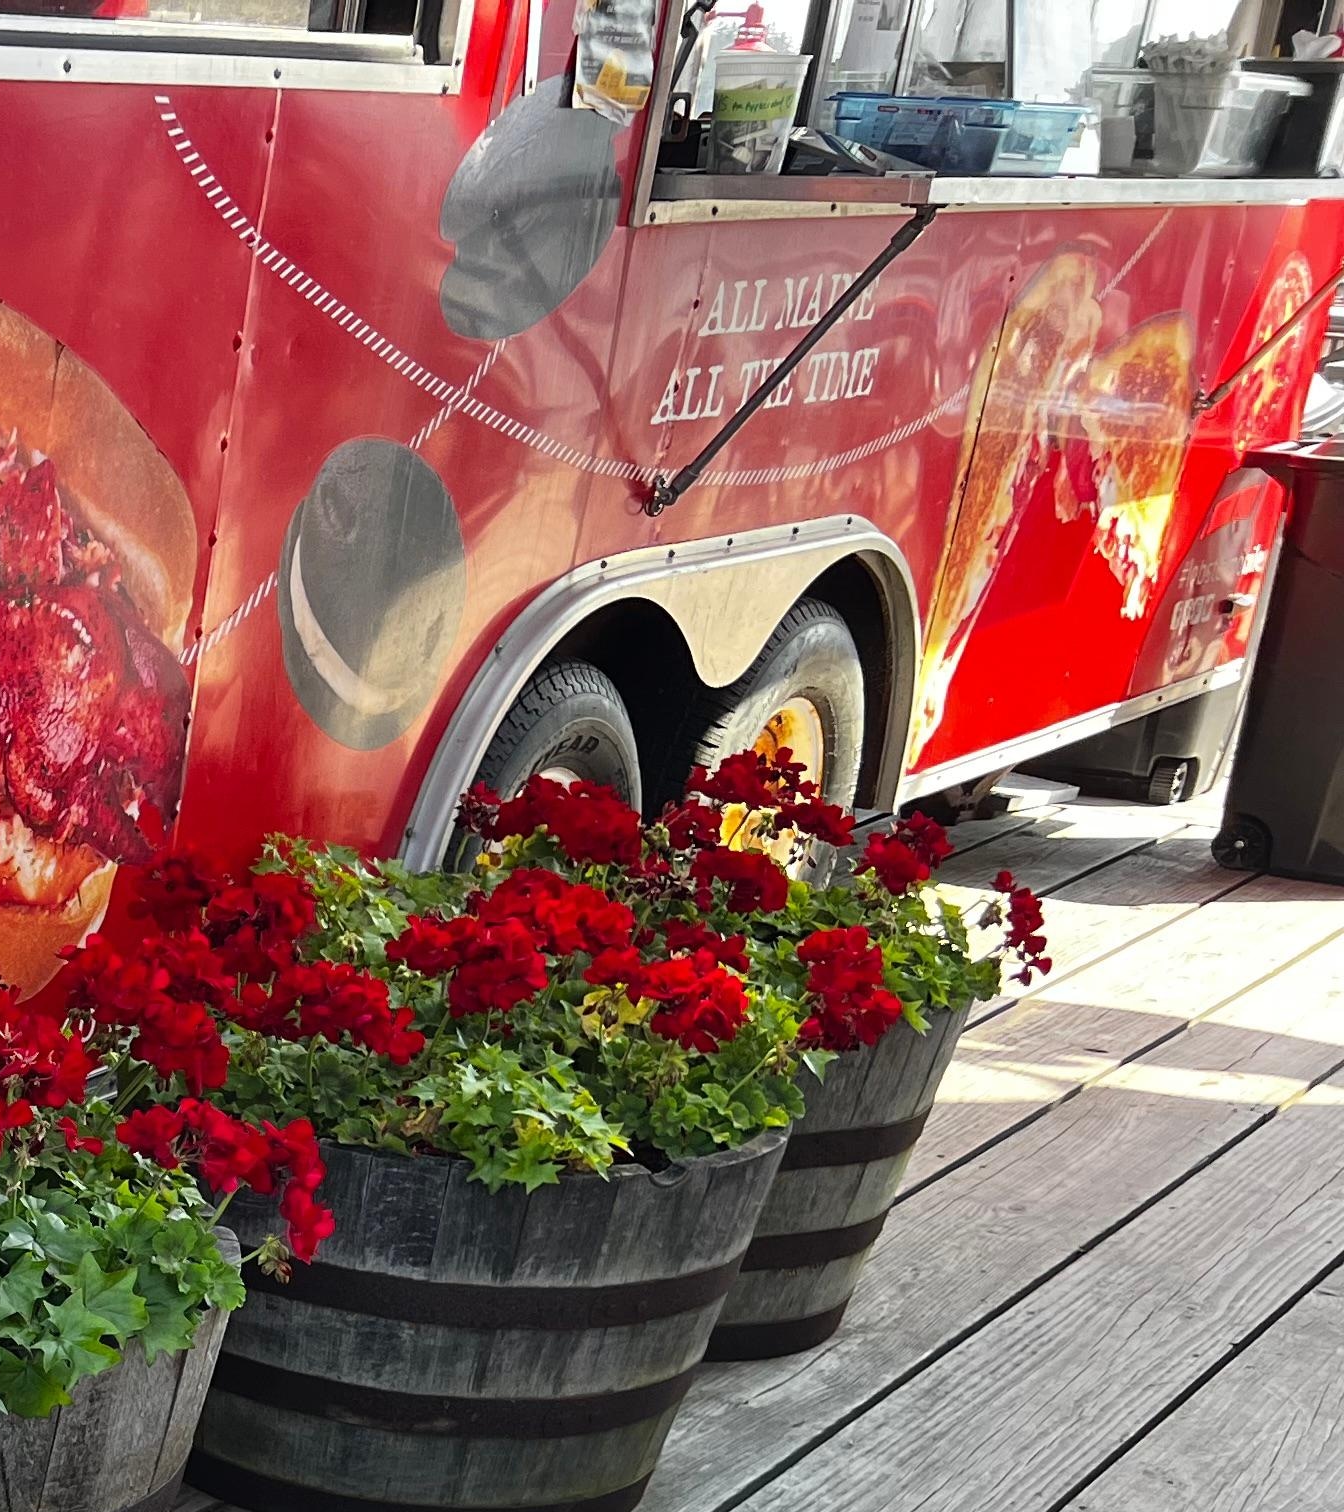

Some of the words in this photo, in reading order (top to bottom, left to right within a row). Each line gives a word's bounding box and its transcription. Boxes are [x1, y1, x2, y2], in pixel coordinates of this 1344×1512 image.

[698, 279, 768, 336] ALL
[650, 365, 724, 425] ALL
[803, 348, 880, 404] TIME
